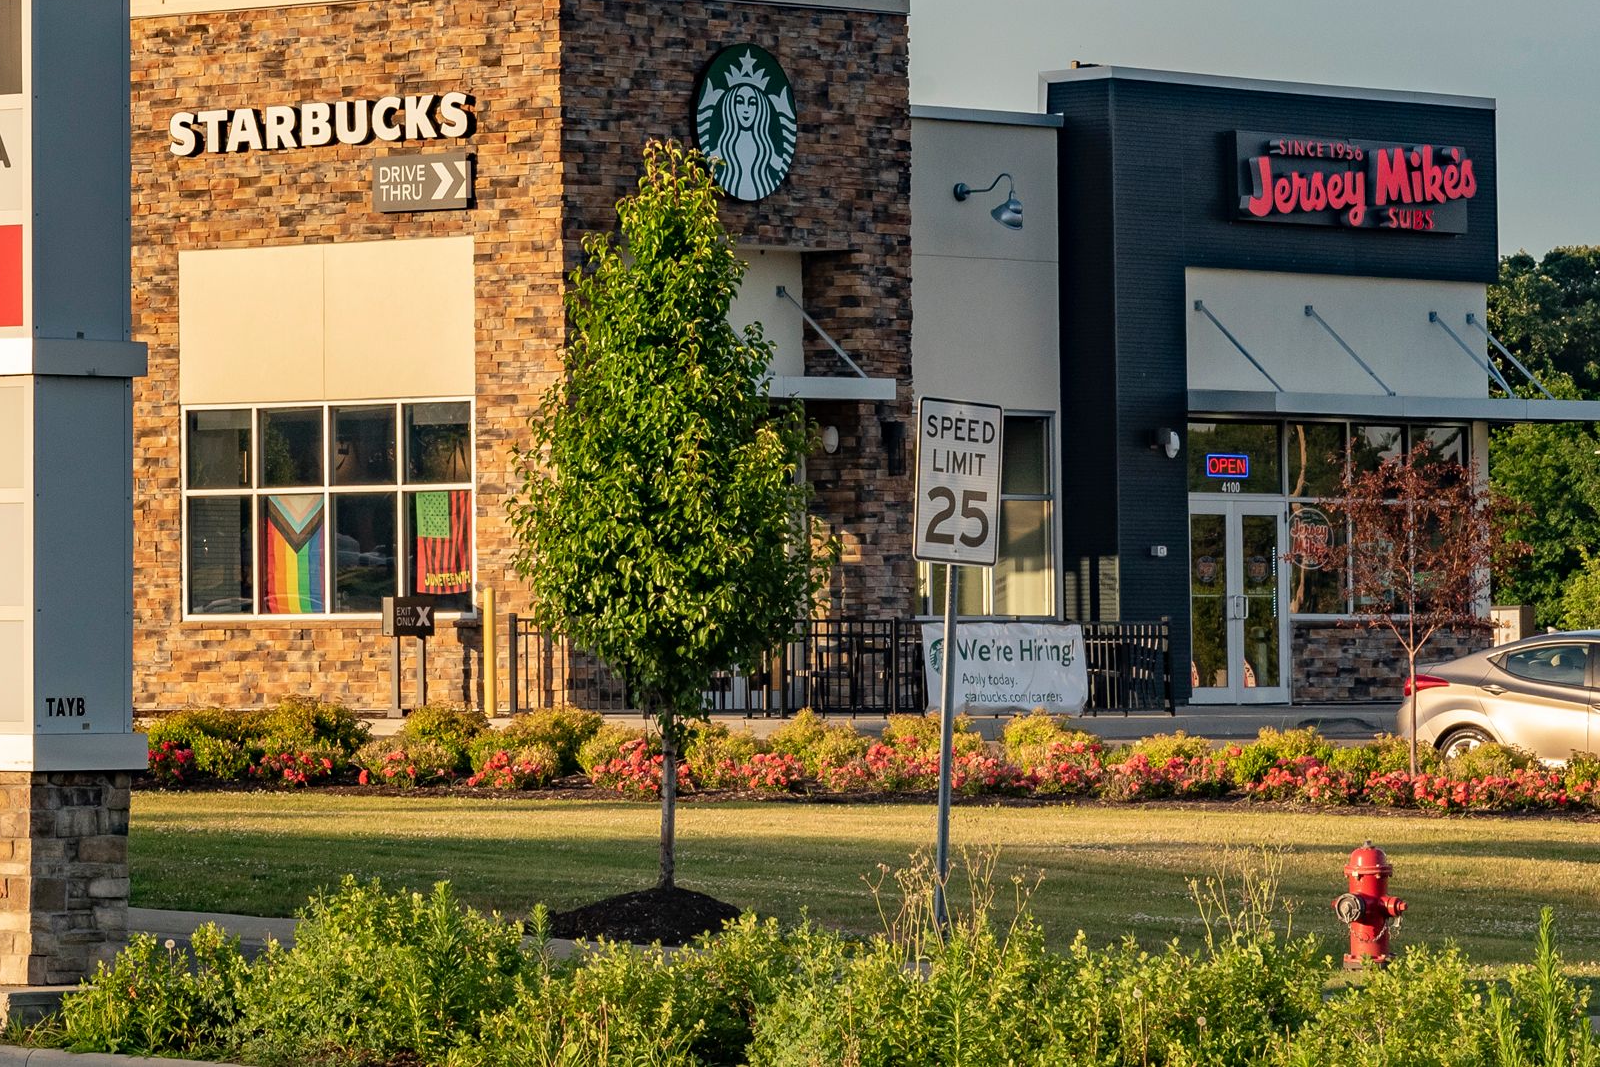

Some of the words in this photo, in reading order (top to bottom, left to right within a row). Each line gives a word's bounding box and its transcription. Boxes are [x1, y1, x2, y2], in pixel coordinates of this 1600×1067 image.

[169, 91, 470, 157] STARBUCKS
[1279, 139, 1324, 158] SINCE
[1329, 141, 1364, 161] 1956
[379, 164, 426, 184] DRIVE
[380, 184, 423, 202] THRU
[1248, 155, 1366, 227] Jersey
[1375, 144, 1478, 206] Mike's
[1387, 206, 1435, 230] SUBS
[926, 414, 995, 444] SPEED
[932, 448, 986, 476] LIMIT
[1208, 457, 1246, 474] OPEN
[1221, 481, 1241, 493] 4100
[925, 486, 989, 547] 25
[424, 571, 471, 586] JUNETEENTH
[396, 606, 412, 616] EXIT
[396, 617, 416, 627] ONLY
[956, 638, 1013, 662] We're
[1019, 637, 1075, 667] Hiring!
[962, 672, 986, 687] Apply
[988, 673, 1018, 688] today.
[45, 697, 87, 717] TAYB
